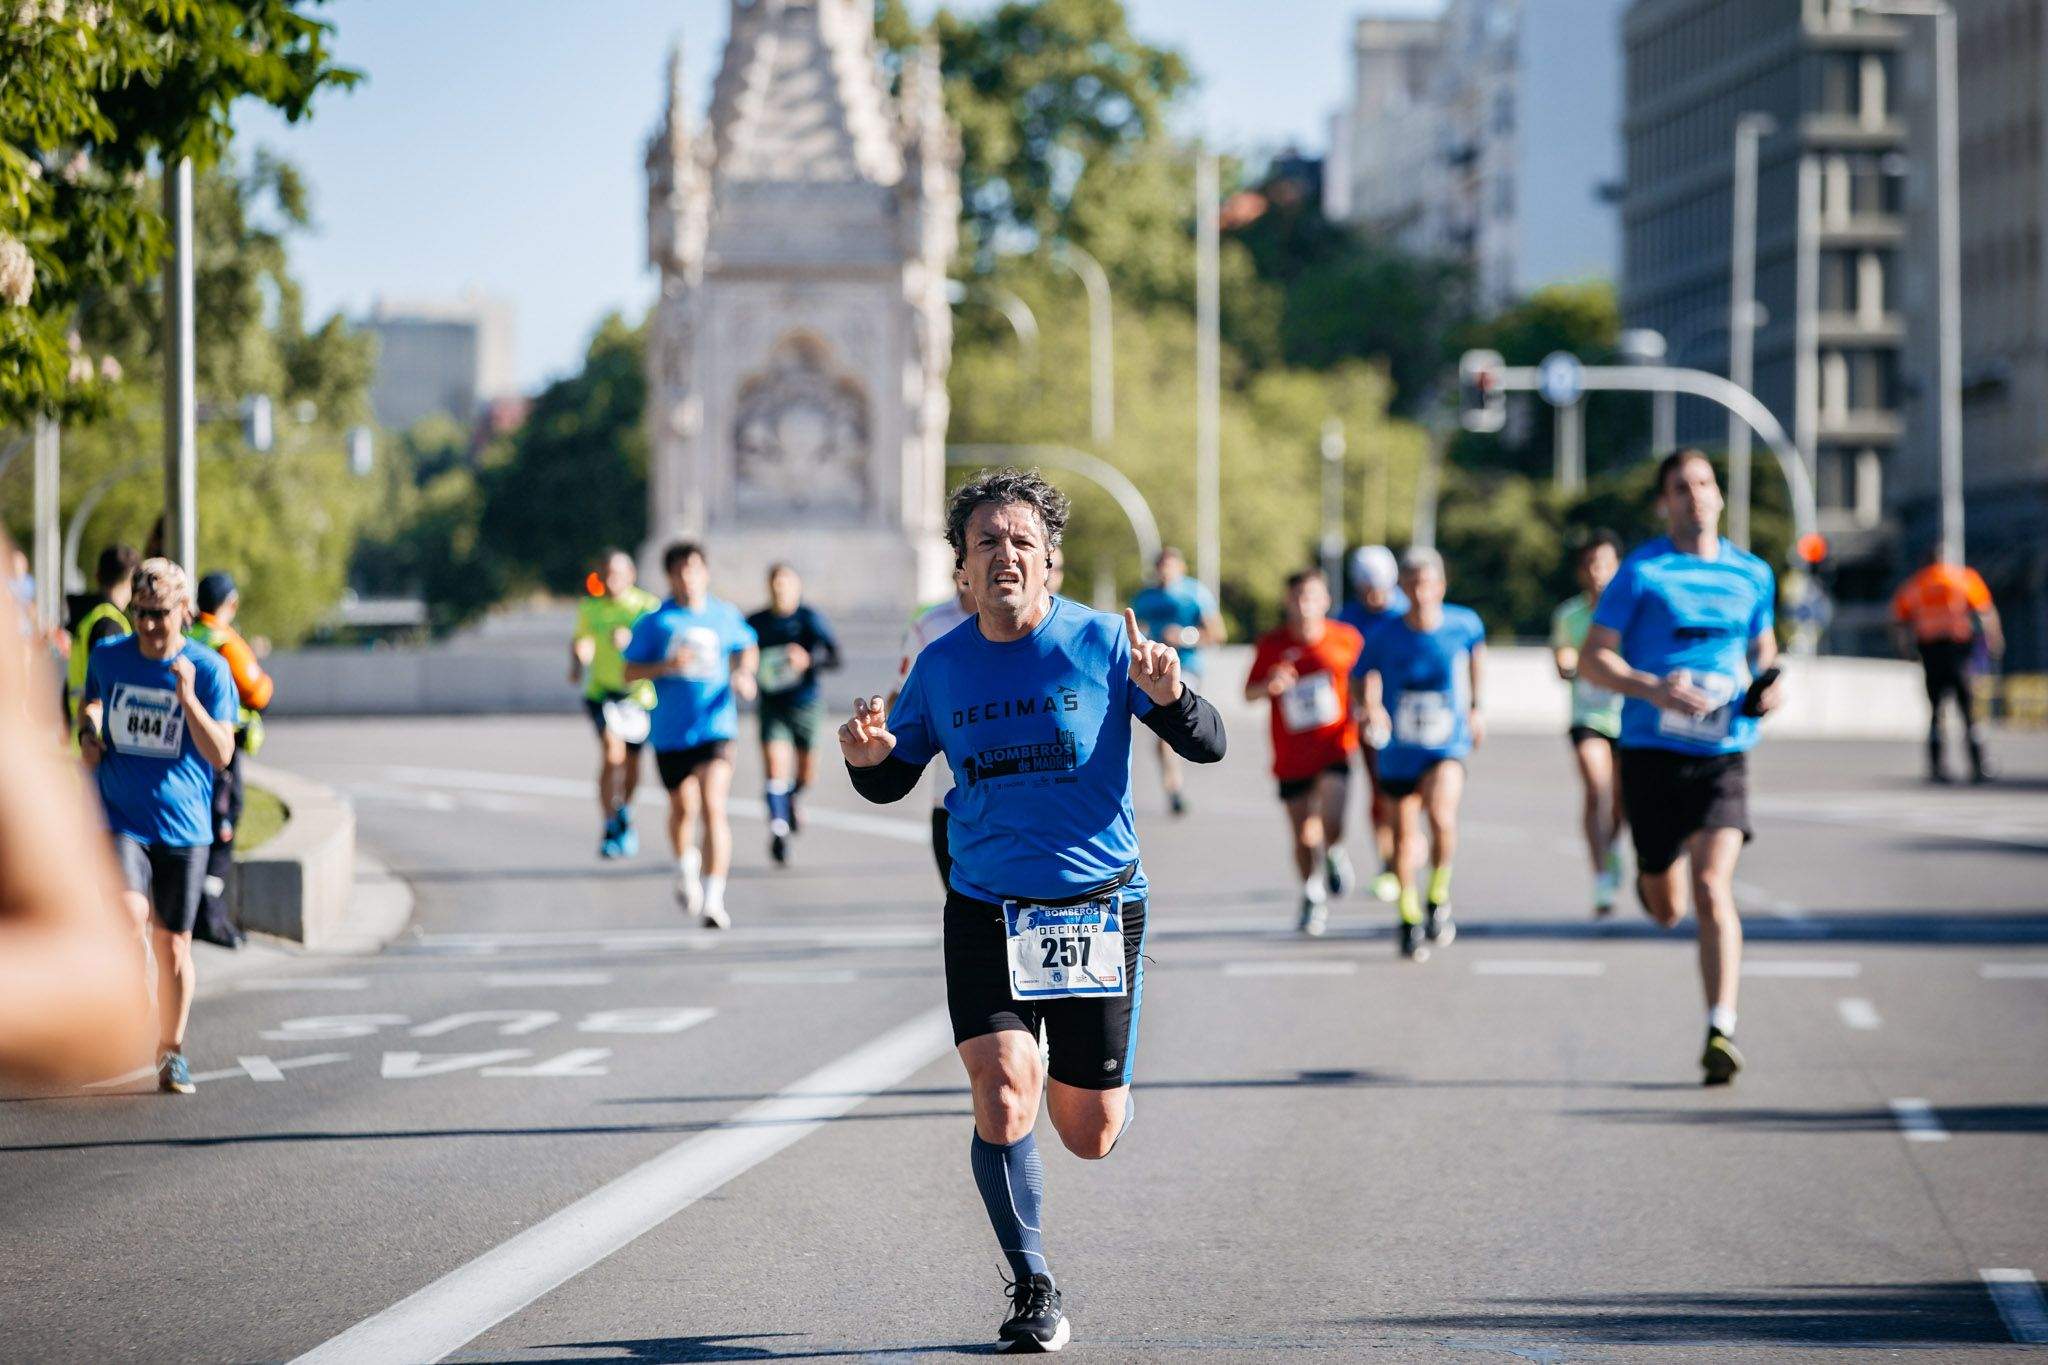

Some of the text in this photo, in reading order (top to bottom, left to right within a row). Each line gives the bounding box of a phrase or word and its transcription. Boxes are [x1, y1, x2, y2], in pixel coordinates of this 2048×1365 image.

[953, 693, 1078, 728] DECIMAS
[127, 715, 162, 736] 844
[983, 744, 1073, 763] BOMBEROS
[1033, 756, 1073, 771] MADRID
[1044, 907, 1099, 918] BOMBEROS
[1039, 924, 1098, 935] DECIMAS
[1041, 937, 1091, 968] 257
